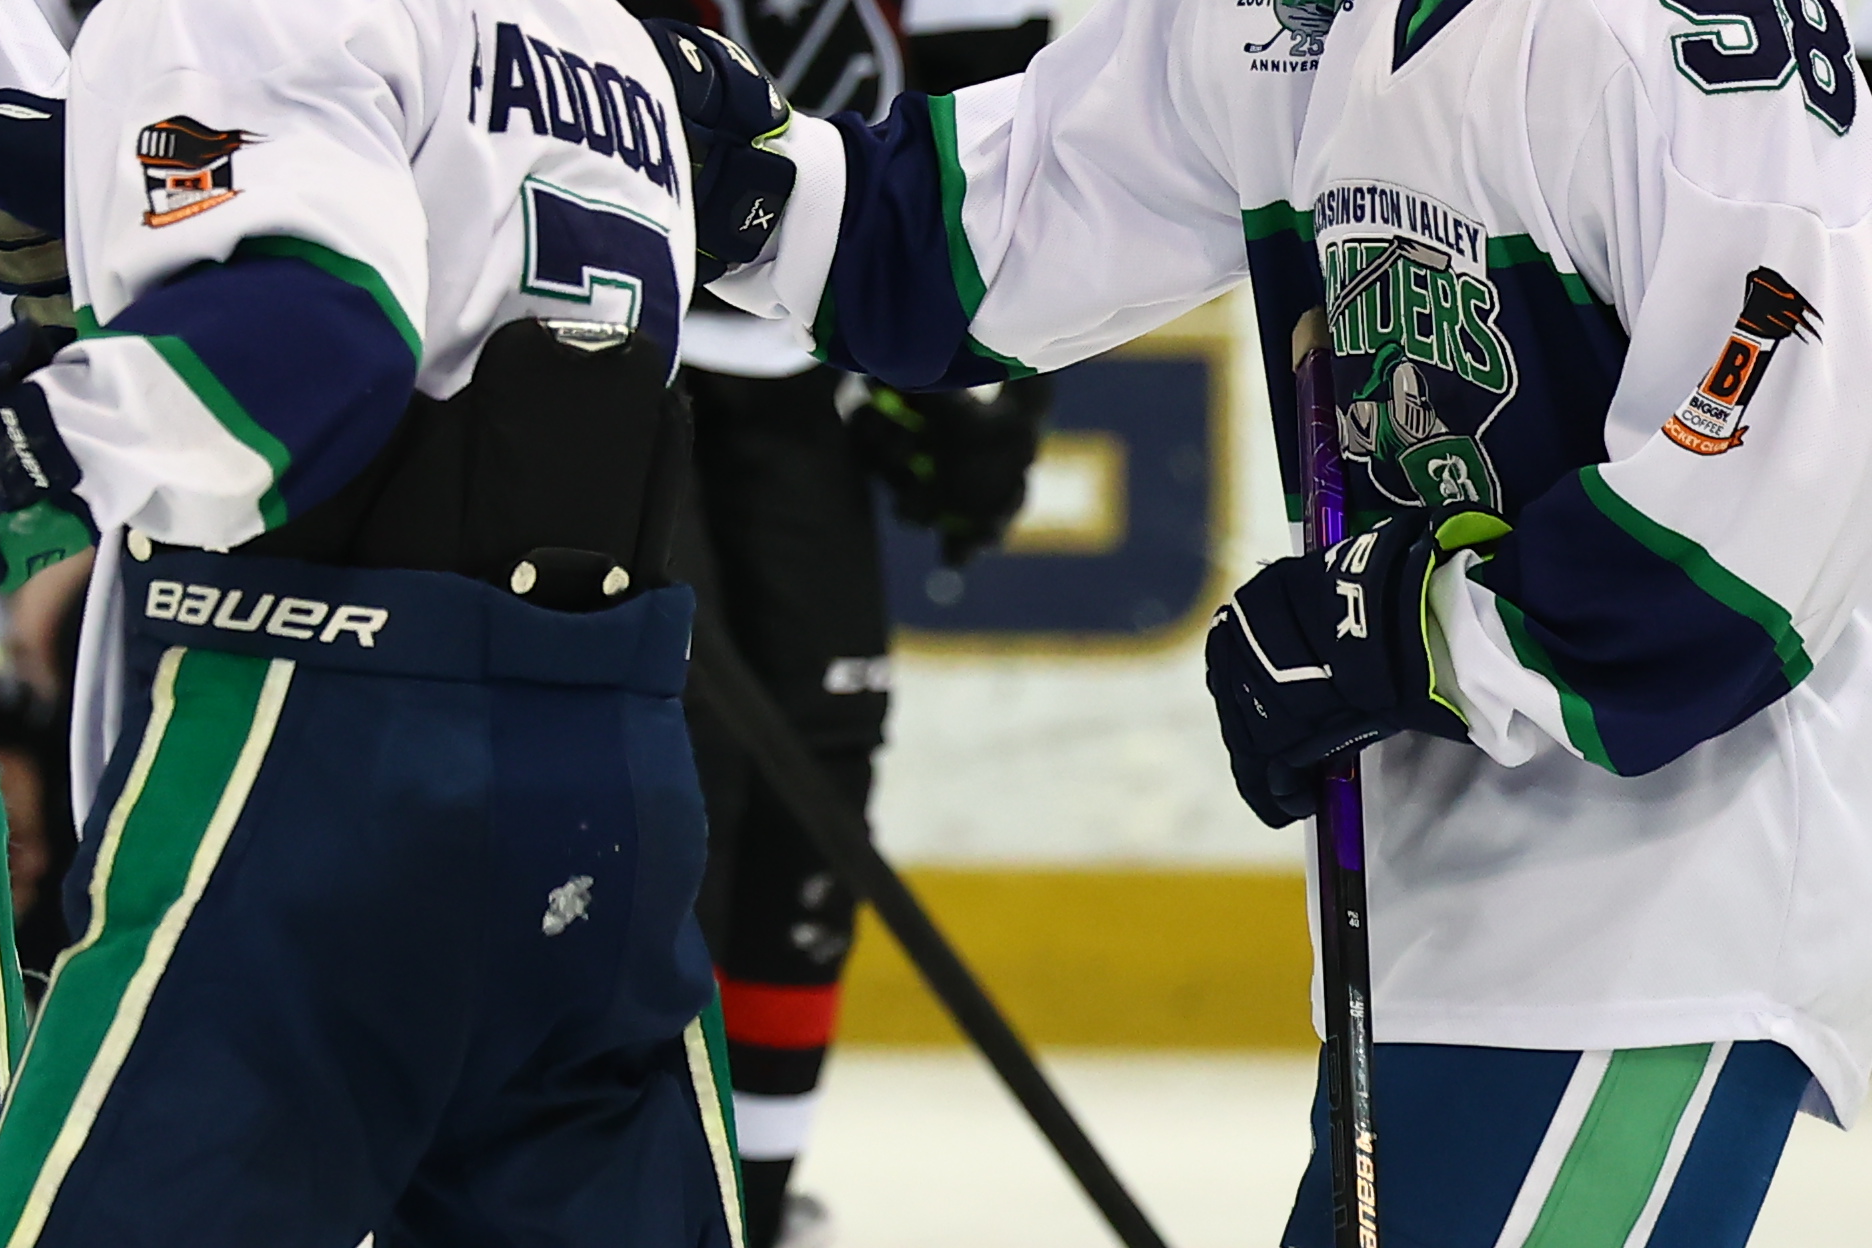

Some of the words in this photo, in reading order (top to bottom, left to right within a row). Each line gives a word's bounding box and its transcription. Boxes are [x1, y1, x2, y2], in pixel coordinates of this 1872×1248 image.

[1250, 58, 1320, 73] ANNIVER
[1289, 29, 1326, 57] 25
[1404, 194, 1481, 265] VALLEY
[521, 173, 682, 389] 7
[1325, 241, 1509, 395] AIDERS
[1708, 339, 1752, 398] B
[1665, 417, 1702, 449] OCKEY
[1681, 409, 1725, 437] COFFEE
[144, 579, 389, 648] BAUER
[1355, 1153, 1378, 1248] BAUE
